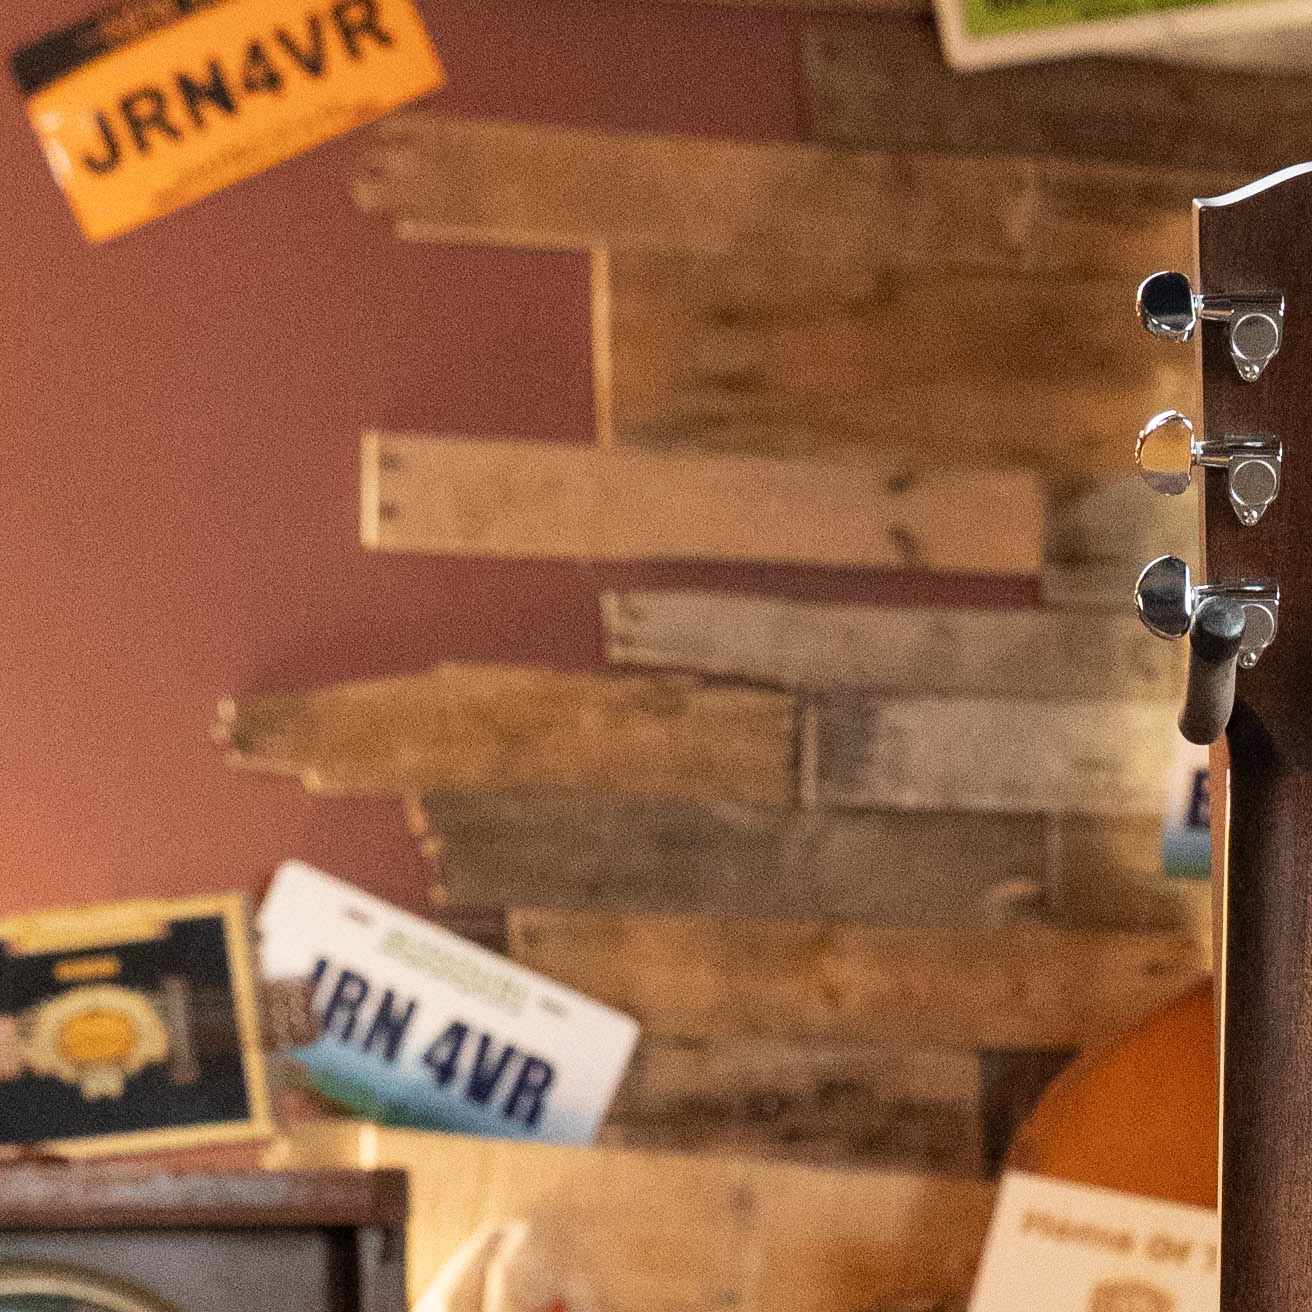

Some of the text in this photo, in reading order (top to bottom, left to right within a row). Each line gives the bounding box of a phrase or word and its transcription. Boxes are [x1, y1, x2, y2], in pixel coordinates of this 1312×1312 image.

[83, 0, 395, 176] JRN4VR
[311, 956, 558, 1130] RN 4VR
